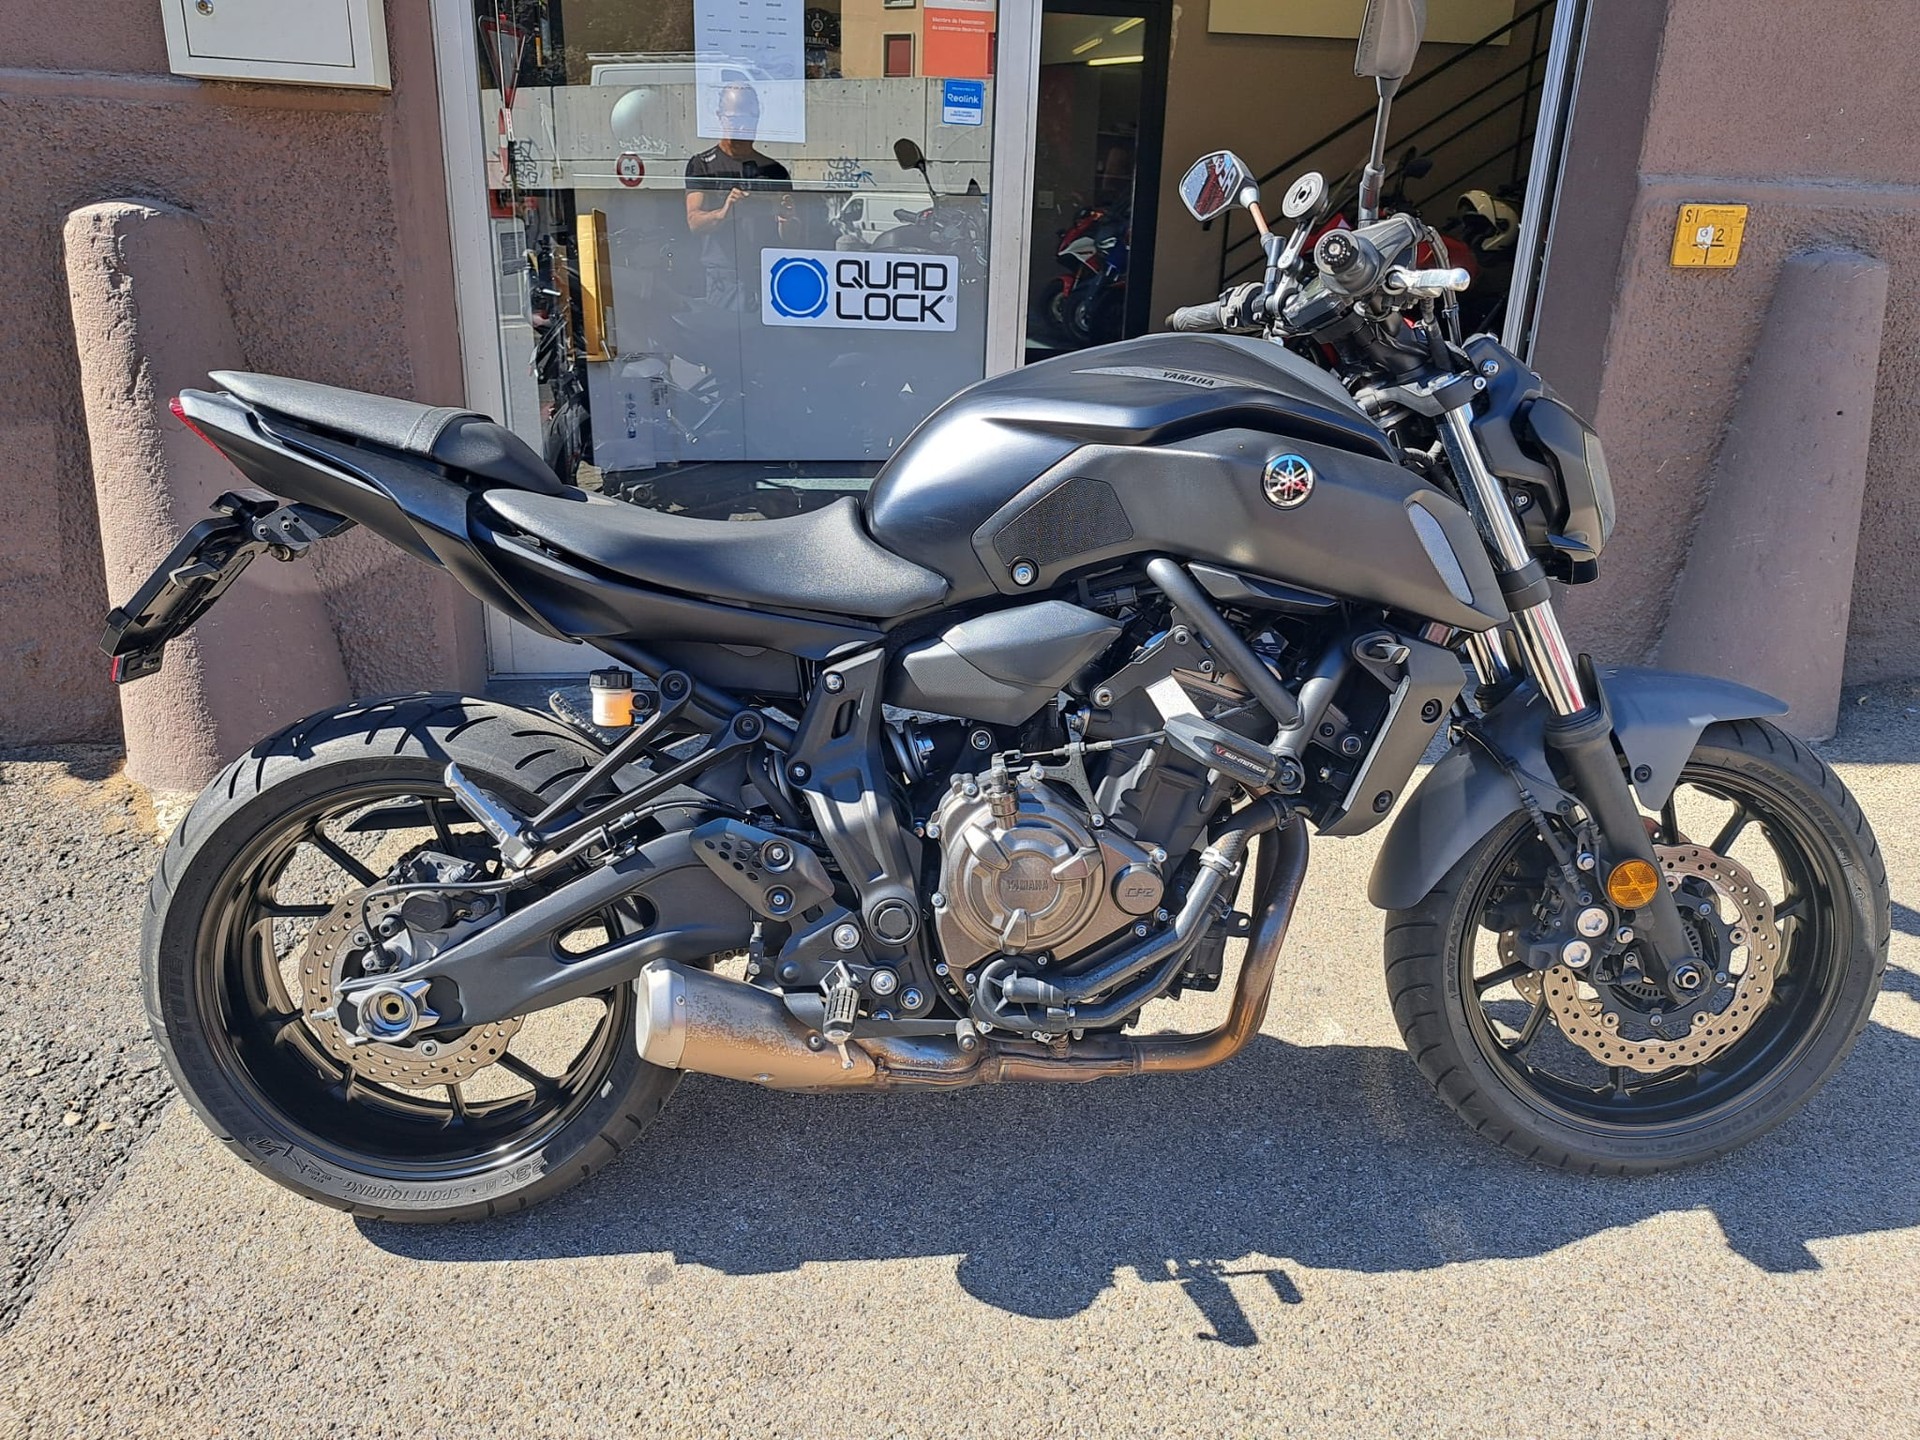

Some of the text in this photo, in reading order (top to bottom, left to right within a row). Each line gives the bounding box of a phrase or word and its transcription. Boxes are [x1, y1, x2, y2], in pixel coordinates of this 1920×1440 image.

[947, 93, 979, 104] Reolink
[836, 259, 948, 292] QUAD
[836, 291, 946, 323] LOCK
[1163, 371, 1215, 386] YAMAHA
[1007, 879, 1050, 892] YAMAHA
